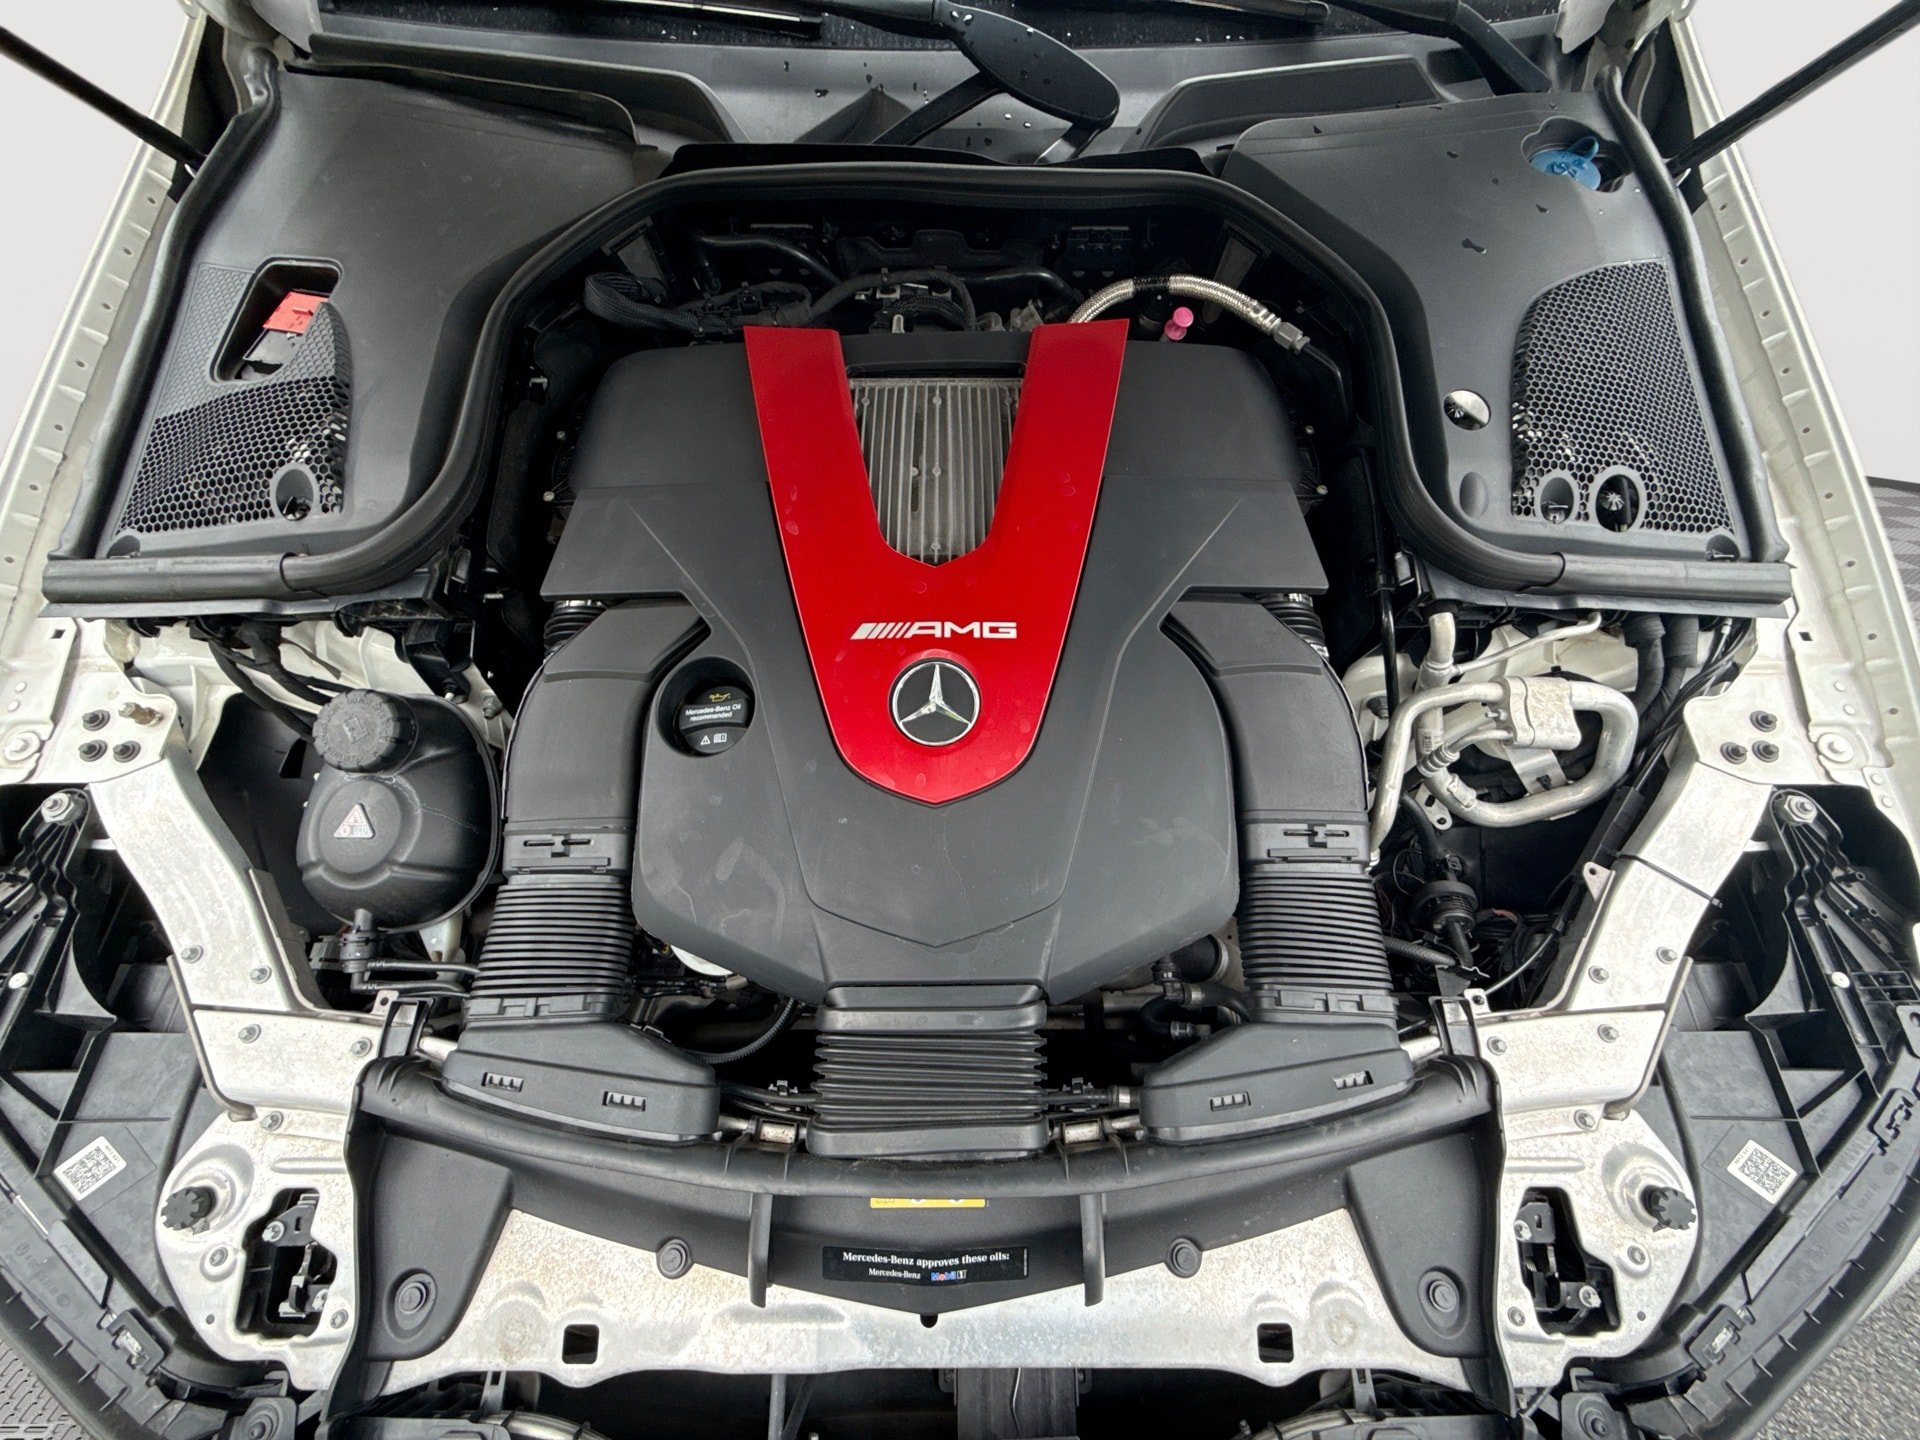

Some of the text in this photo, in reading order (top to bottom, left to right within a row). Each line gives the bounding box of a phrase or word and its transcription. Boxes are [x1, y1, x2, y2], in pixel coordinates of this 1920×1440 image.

[904, 621, 1017, 639] AMG
[685, 705, 731, 716] Mercedes-Benz
[690, 711, 733, 721] recommended
[842, 1251, 1010, 1269] Mercedes-Benz approves these oils:
[868, 1267, 921, 1280] Mercedes-Benz
[930, 1271, 957, 1281] Mobil
